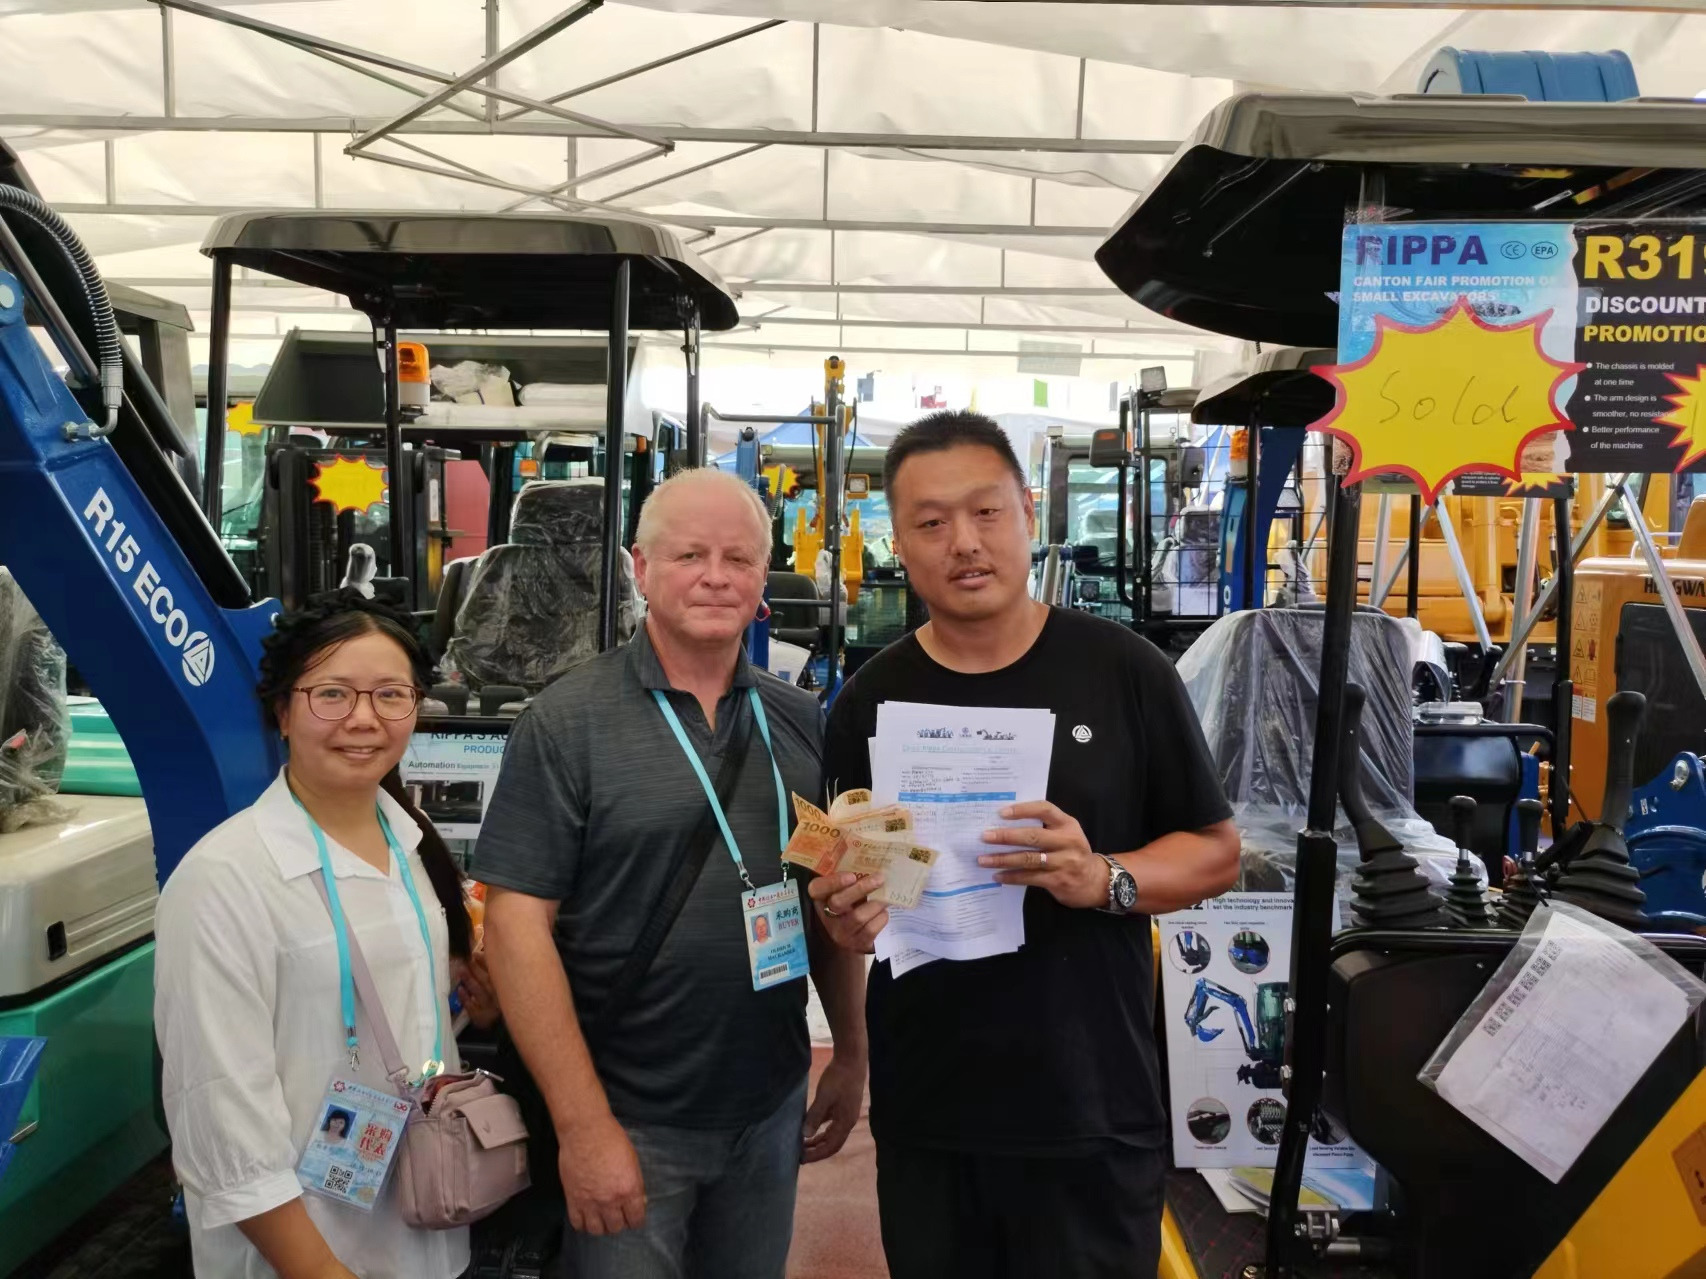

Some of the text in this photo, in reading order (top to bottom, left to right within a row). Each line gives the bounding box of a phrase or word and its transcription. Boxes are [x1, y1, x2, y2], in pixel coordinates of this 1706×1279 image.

[1357, 235, 1489, 266] RIPPA
[1534, 246, 1554, 255] EPA
[1584, 234, 1706, 280] R31
[1354, 275, 1411, 287] CANTON
[1415, 275, 1447, 287] FAIR
[1451, 275, 1535, 287] PROMOTION
[1353, 290, 1399, 302] SMALL
[1585, 296, 1706, 314] DISCOUNT
[1596, 362, 1675, 370] The chassis is molded
[1594, 394, 1608, 402] The
[1624, 394, 1649, 403] design
[1650, 394, 1657, 402] is
[1592, 410, 1628, 419] smoother,
[1591, 425, 1660, 435] Better performance
[84, 487, 189, 646] R15 ECO
[408, 761, 455, 769] Automation
[795, 797, 822, 820] 1000
[802, 821, 841, 839] 1000
[1227, 897, 1260, 905] technology
[778, 918, 800, 930] BUYER
